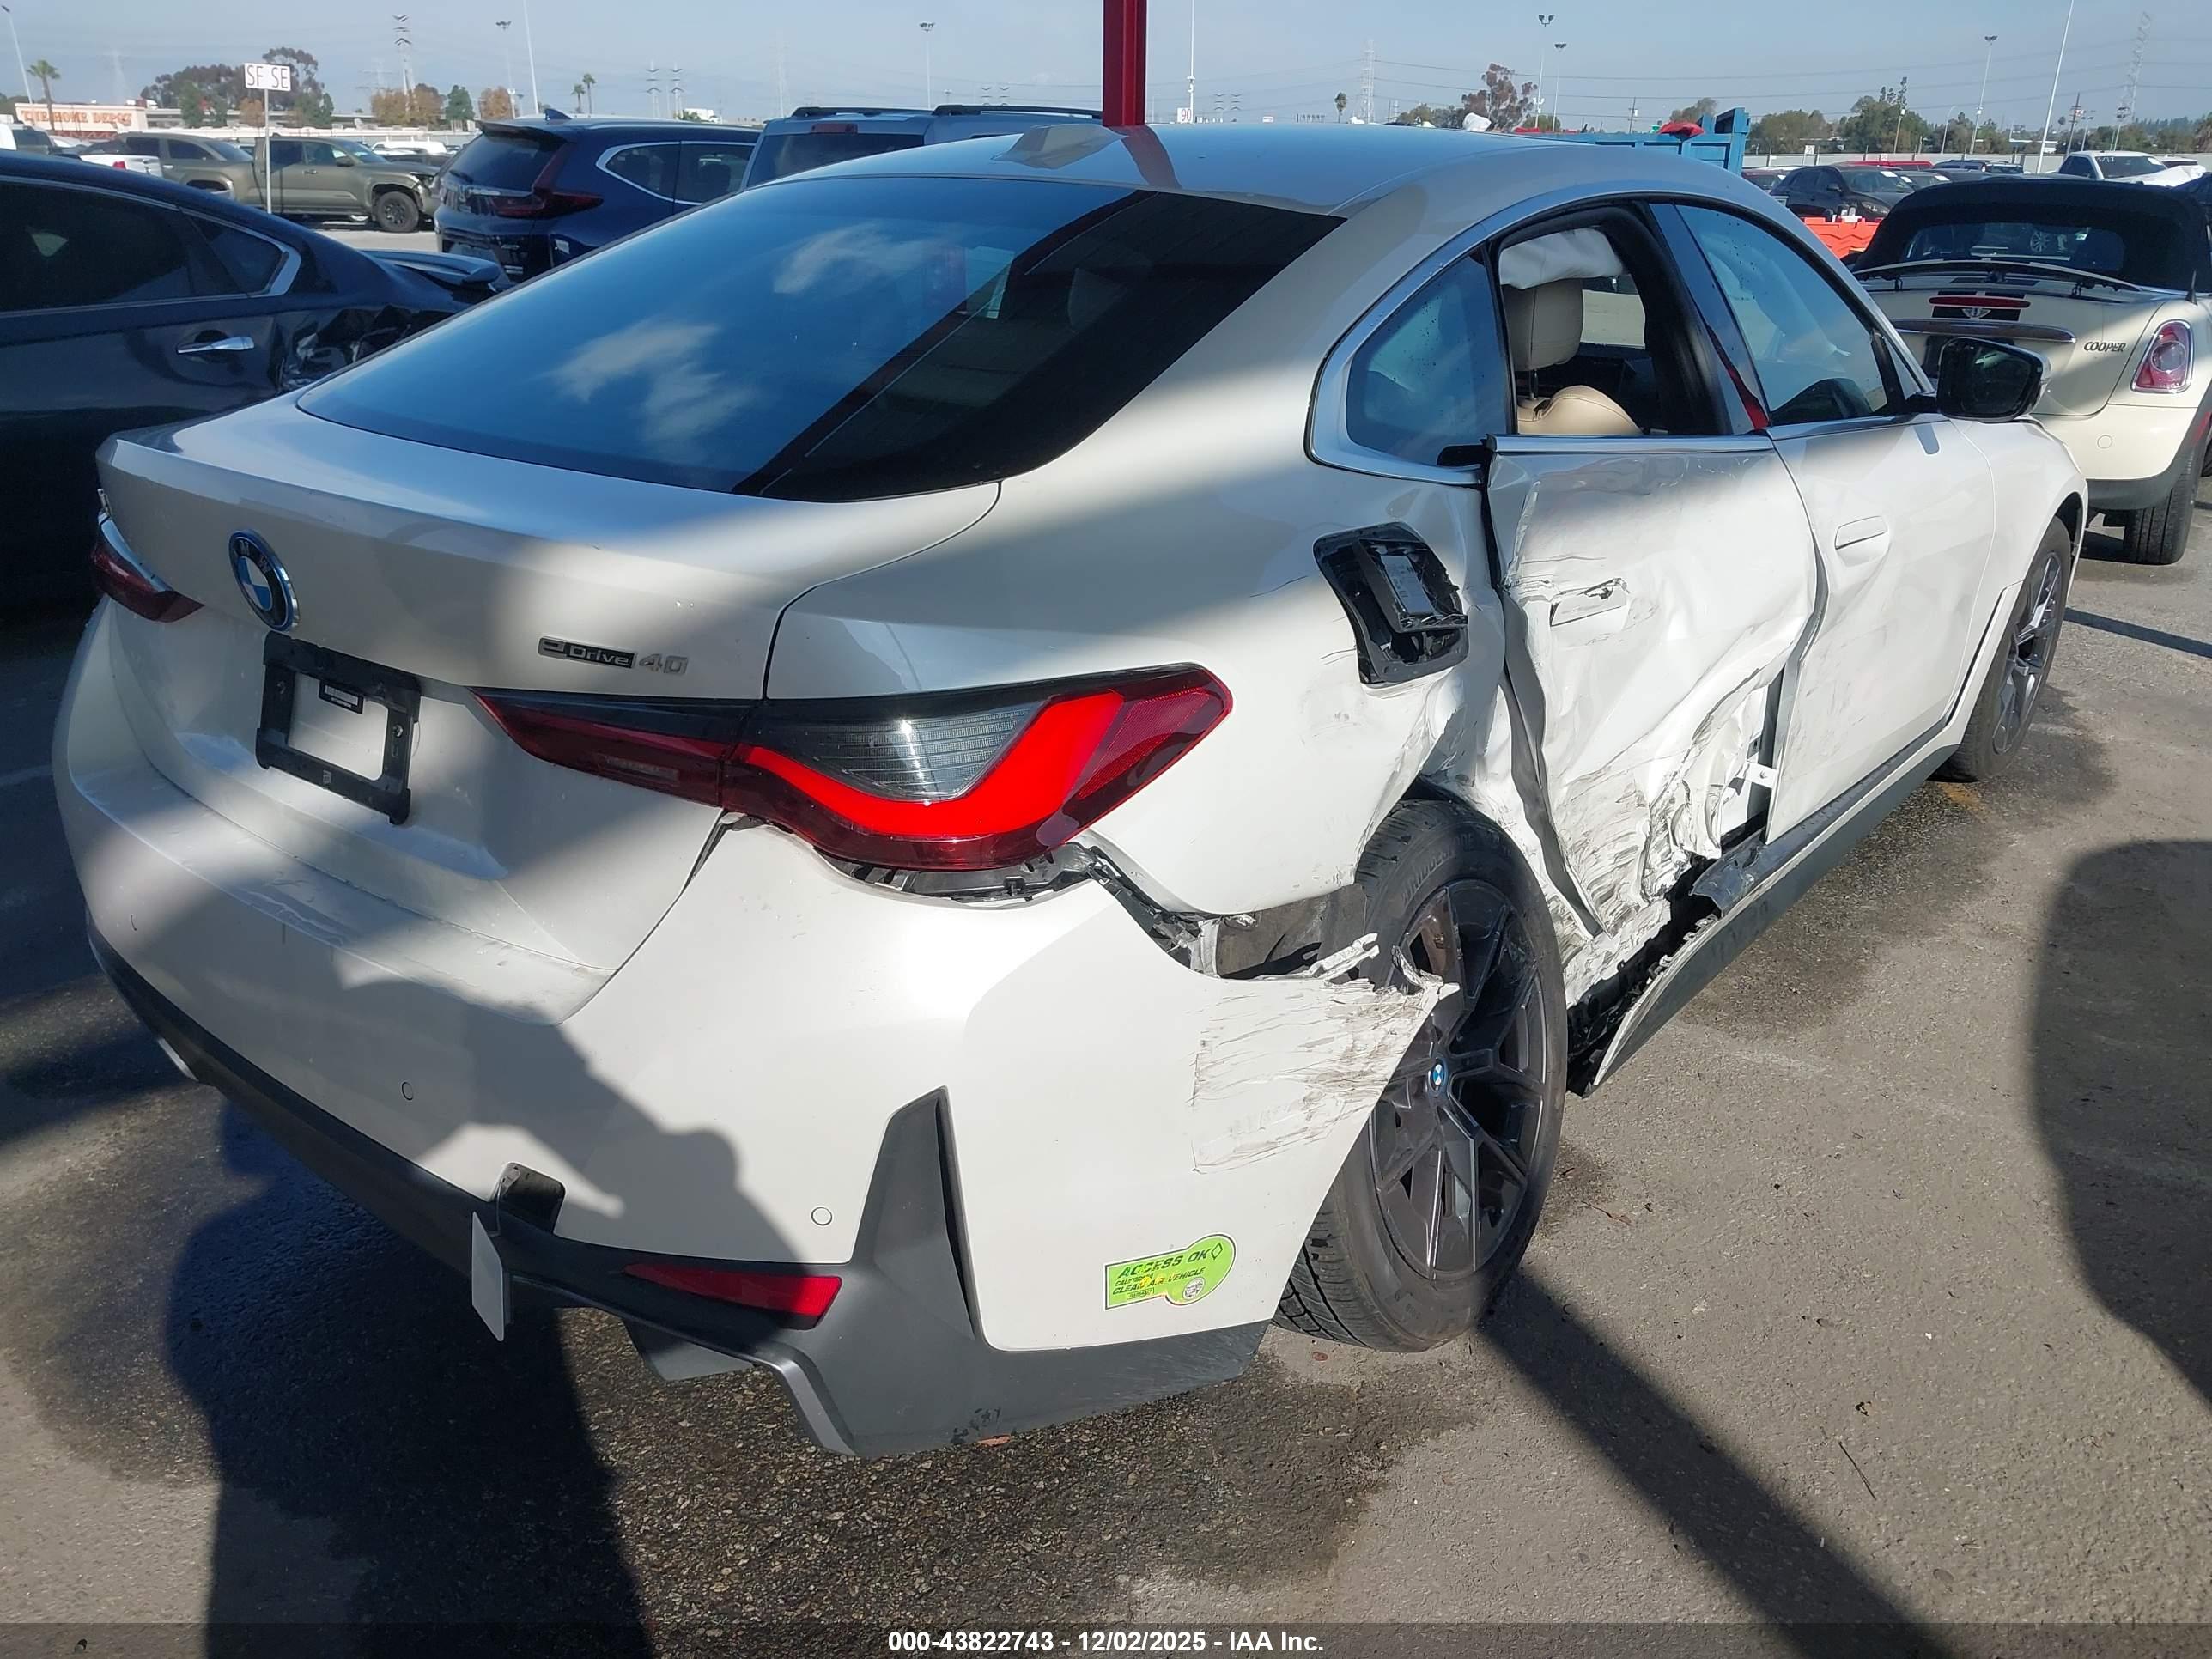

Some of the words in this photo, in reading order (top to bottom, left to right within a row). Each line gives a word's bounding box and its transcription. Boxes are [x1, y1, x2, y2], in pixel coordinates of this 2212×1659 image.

[246, 64, 264, 86] SF
[271, 67, 289, 88] SE
[21, 110, 50, 122] THE
[53, 111, 88, 123] HOME
[92, 112, 132, 125] DEPOT
[1181, 108, 1192, 121] 90
[2083, 341, 2126, 352] COOPER
[1118, 1255, 1184, 1279] ACCESS
[1187, 1248, 1212, 1263] OK
[1112, 1278, 1147, 1295] CLEAN
[1168, 1267, 1207, 1282] VEHICLE
